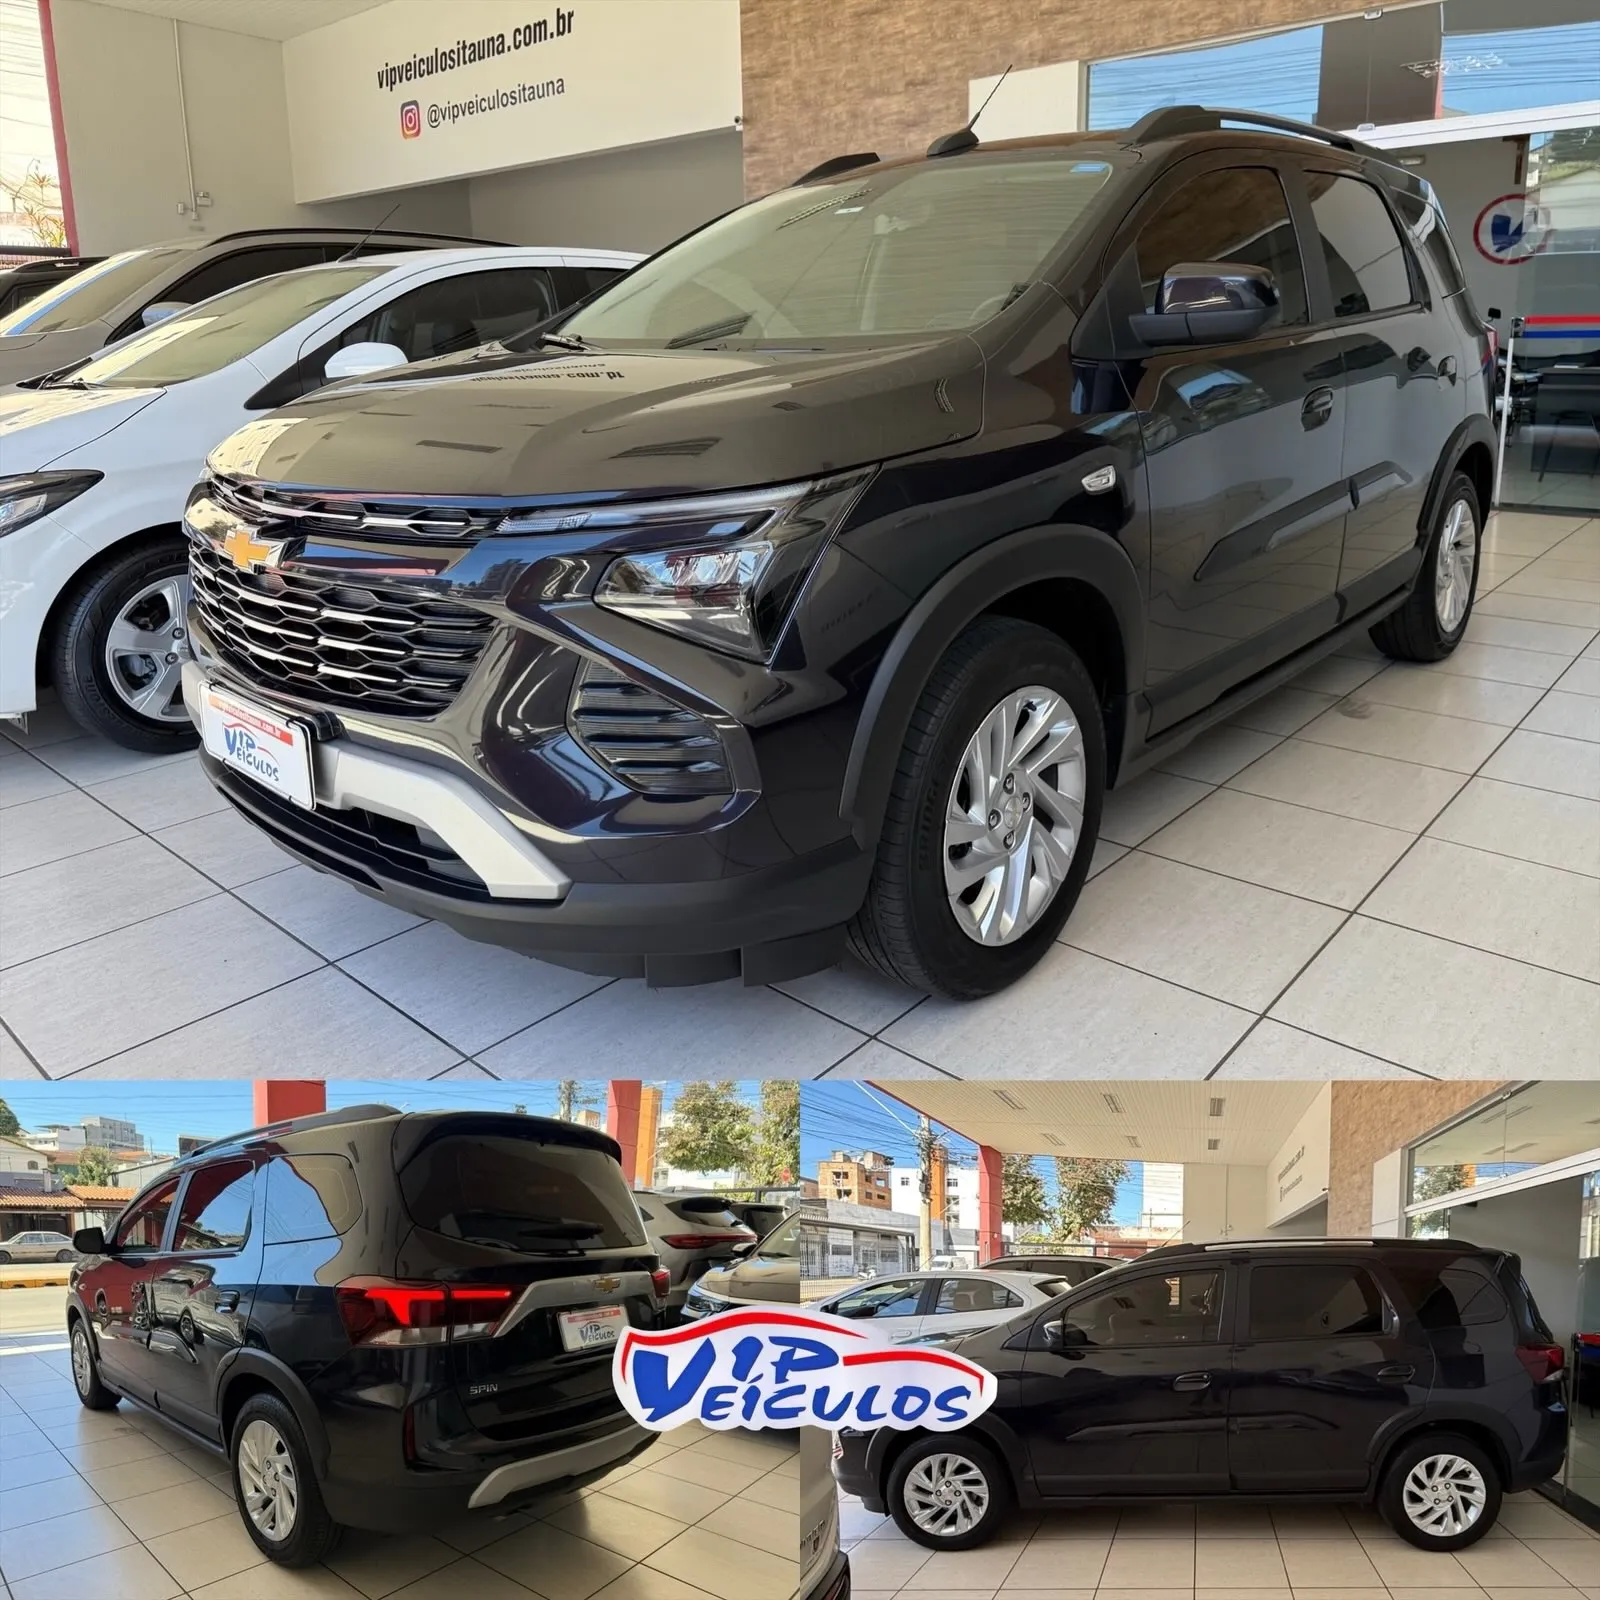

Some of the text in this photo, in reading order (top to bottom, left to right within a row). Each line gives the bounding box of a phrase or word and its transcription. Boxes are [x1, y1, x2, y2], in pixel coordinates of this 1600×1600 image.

[377, 8, 575, 92] vipveiculositauna.com.br
[427, 77, 566, 129] @vipveiculositauna
[469, 1383, 498, 1395] SPIN
